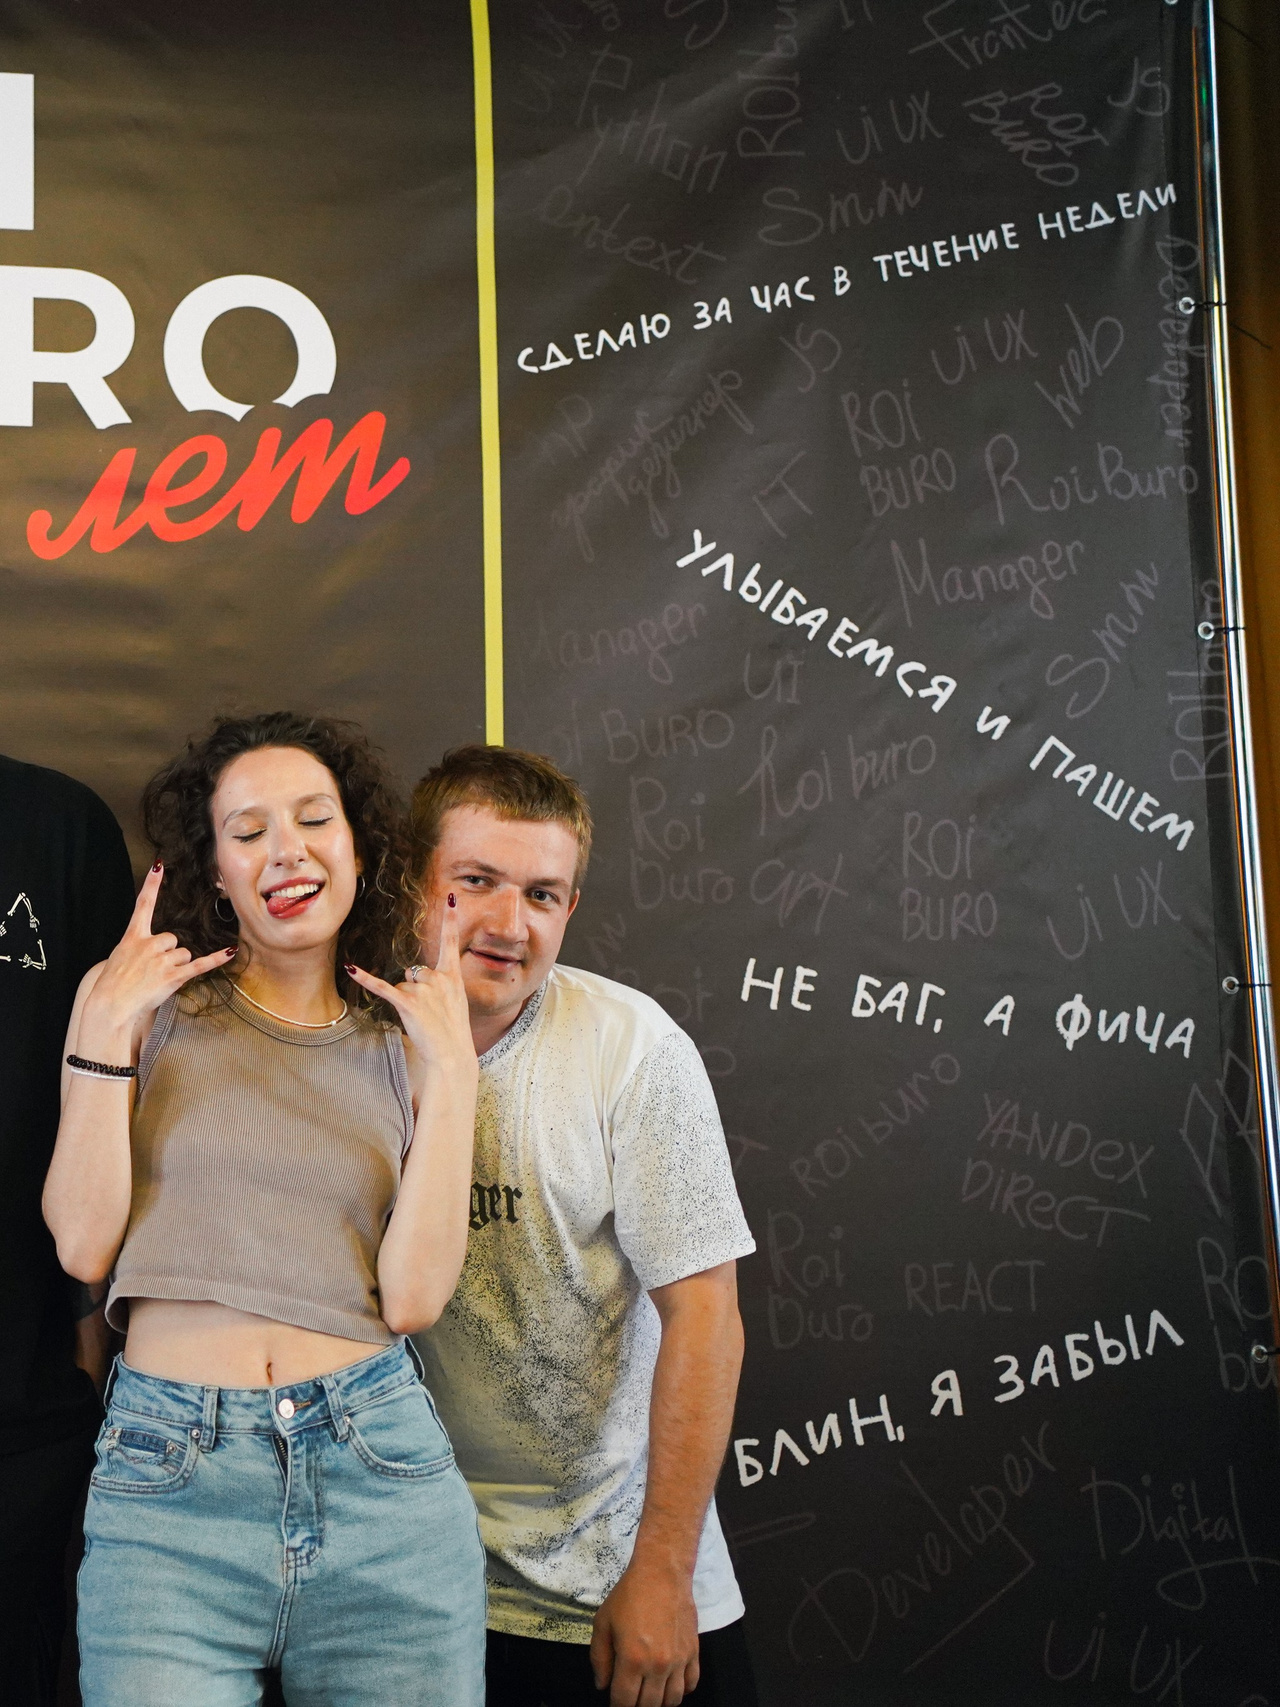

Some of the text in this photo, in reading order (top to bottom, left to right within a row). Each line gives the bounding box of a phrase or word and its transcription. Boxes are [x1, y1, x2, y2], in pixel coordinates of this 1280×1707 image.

[516, 182, 1178, 375] СДЕЛАЮ ЗА ЧАС В ТЕЧЕНИЕ НЕДЕЛИ
[27, 410, 412, 560] лет
[676, 528, 959, 714] УЛЫБАЕМСЯ
[1029, 734, 1196, 853] ПАШЕМ
[739, 956, 1197, 1060] НЕ БАГ, А ФИЧА
[904, 1260, 1046, 1318] REACT
[734, 1308, 1185, 1488] БЛИН, Я ЗАБЫЛ
